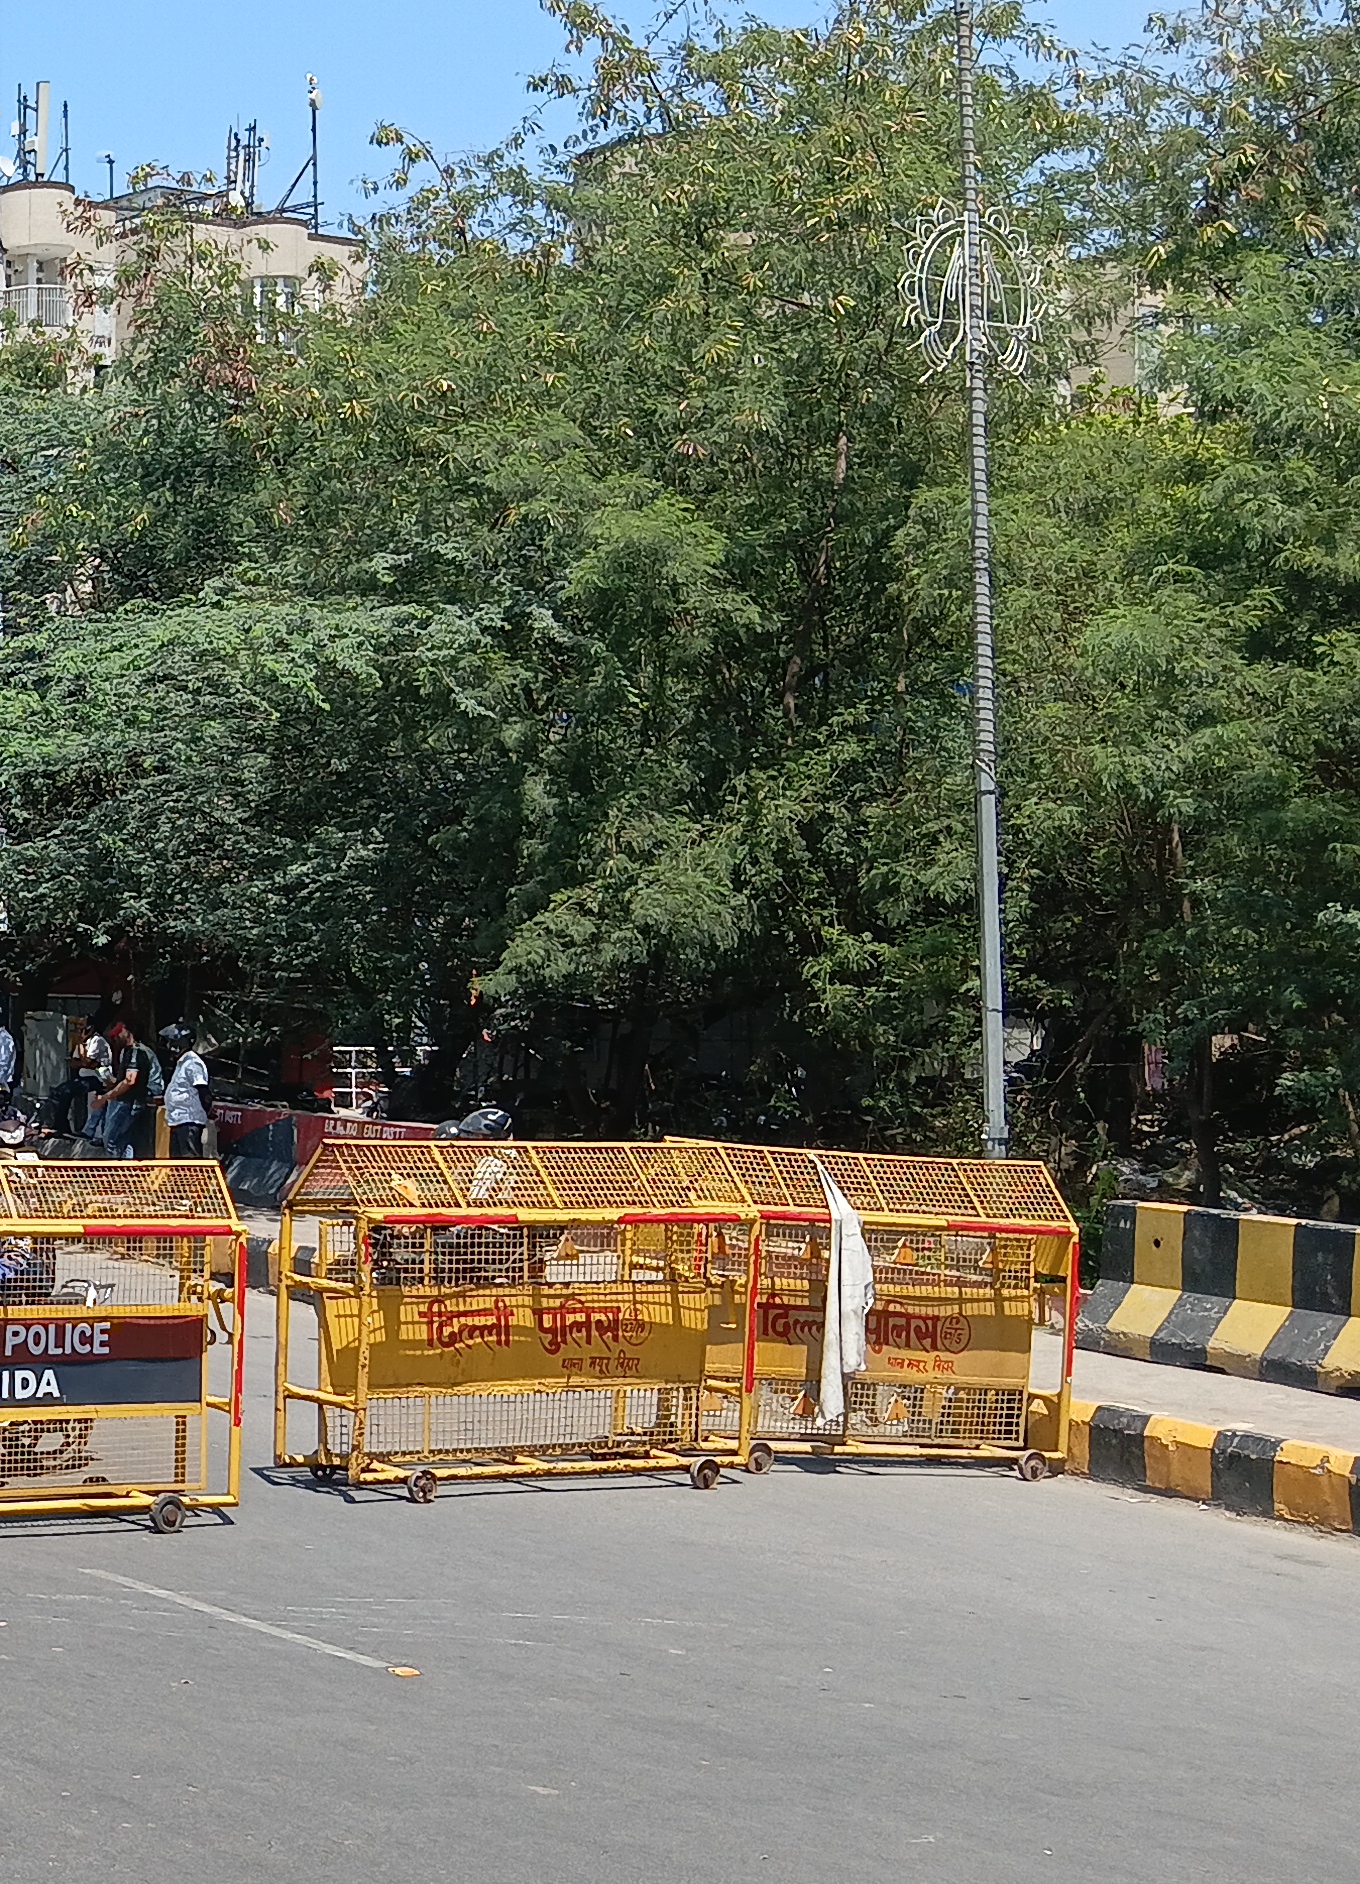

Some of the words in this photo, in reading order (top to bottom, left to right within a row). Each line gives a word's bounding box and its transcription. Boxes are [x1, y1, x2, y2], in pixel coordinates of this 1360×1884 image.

[4, 1321, 111, 1357] POLICE
[418, 1298, 514, 1357] दिल्ली
[533, 1298, 622, 1355] पुलिस
